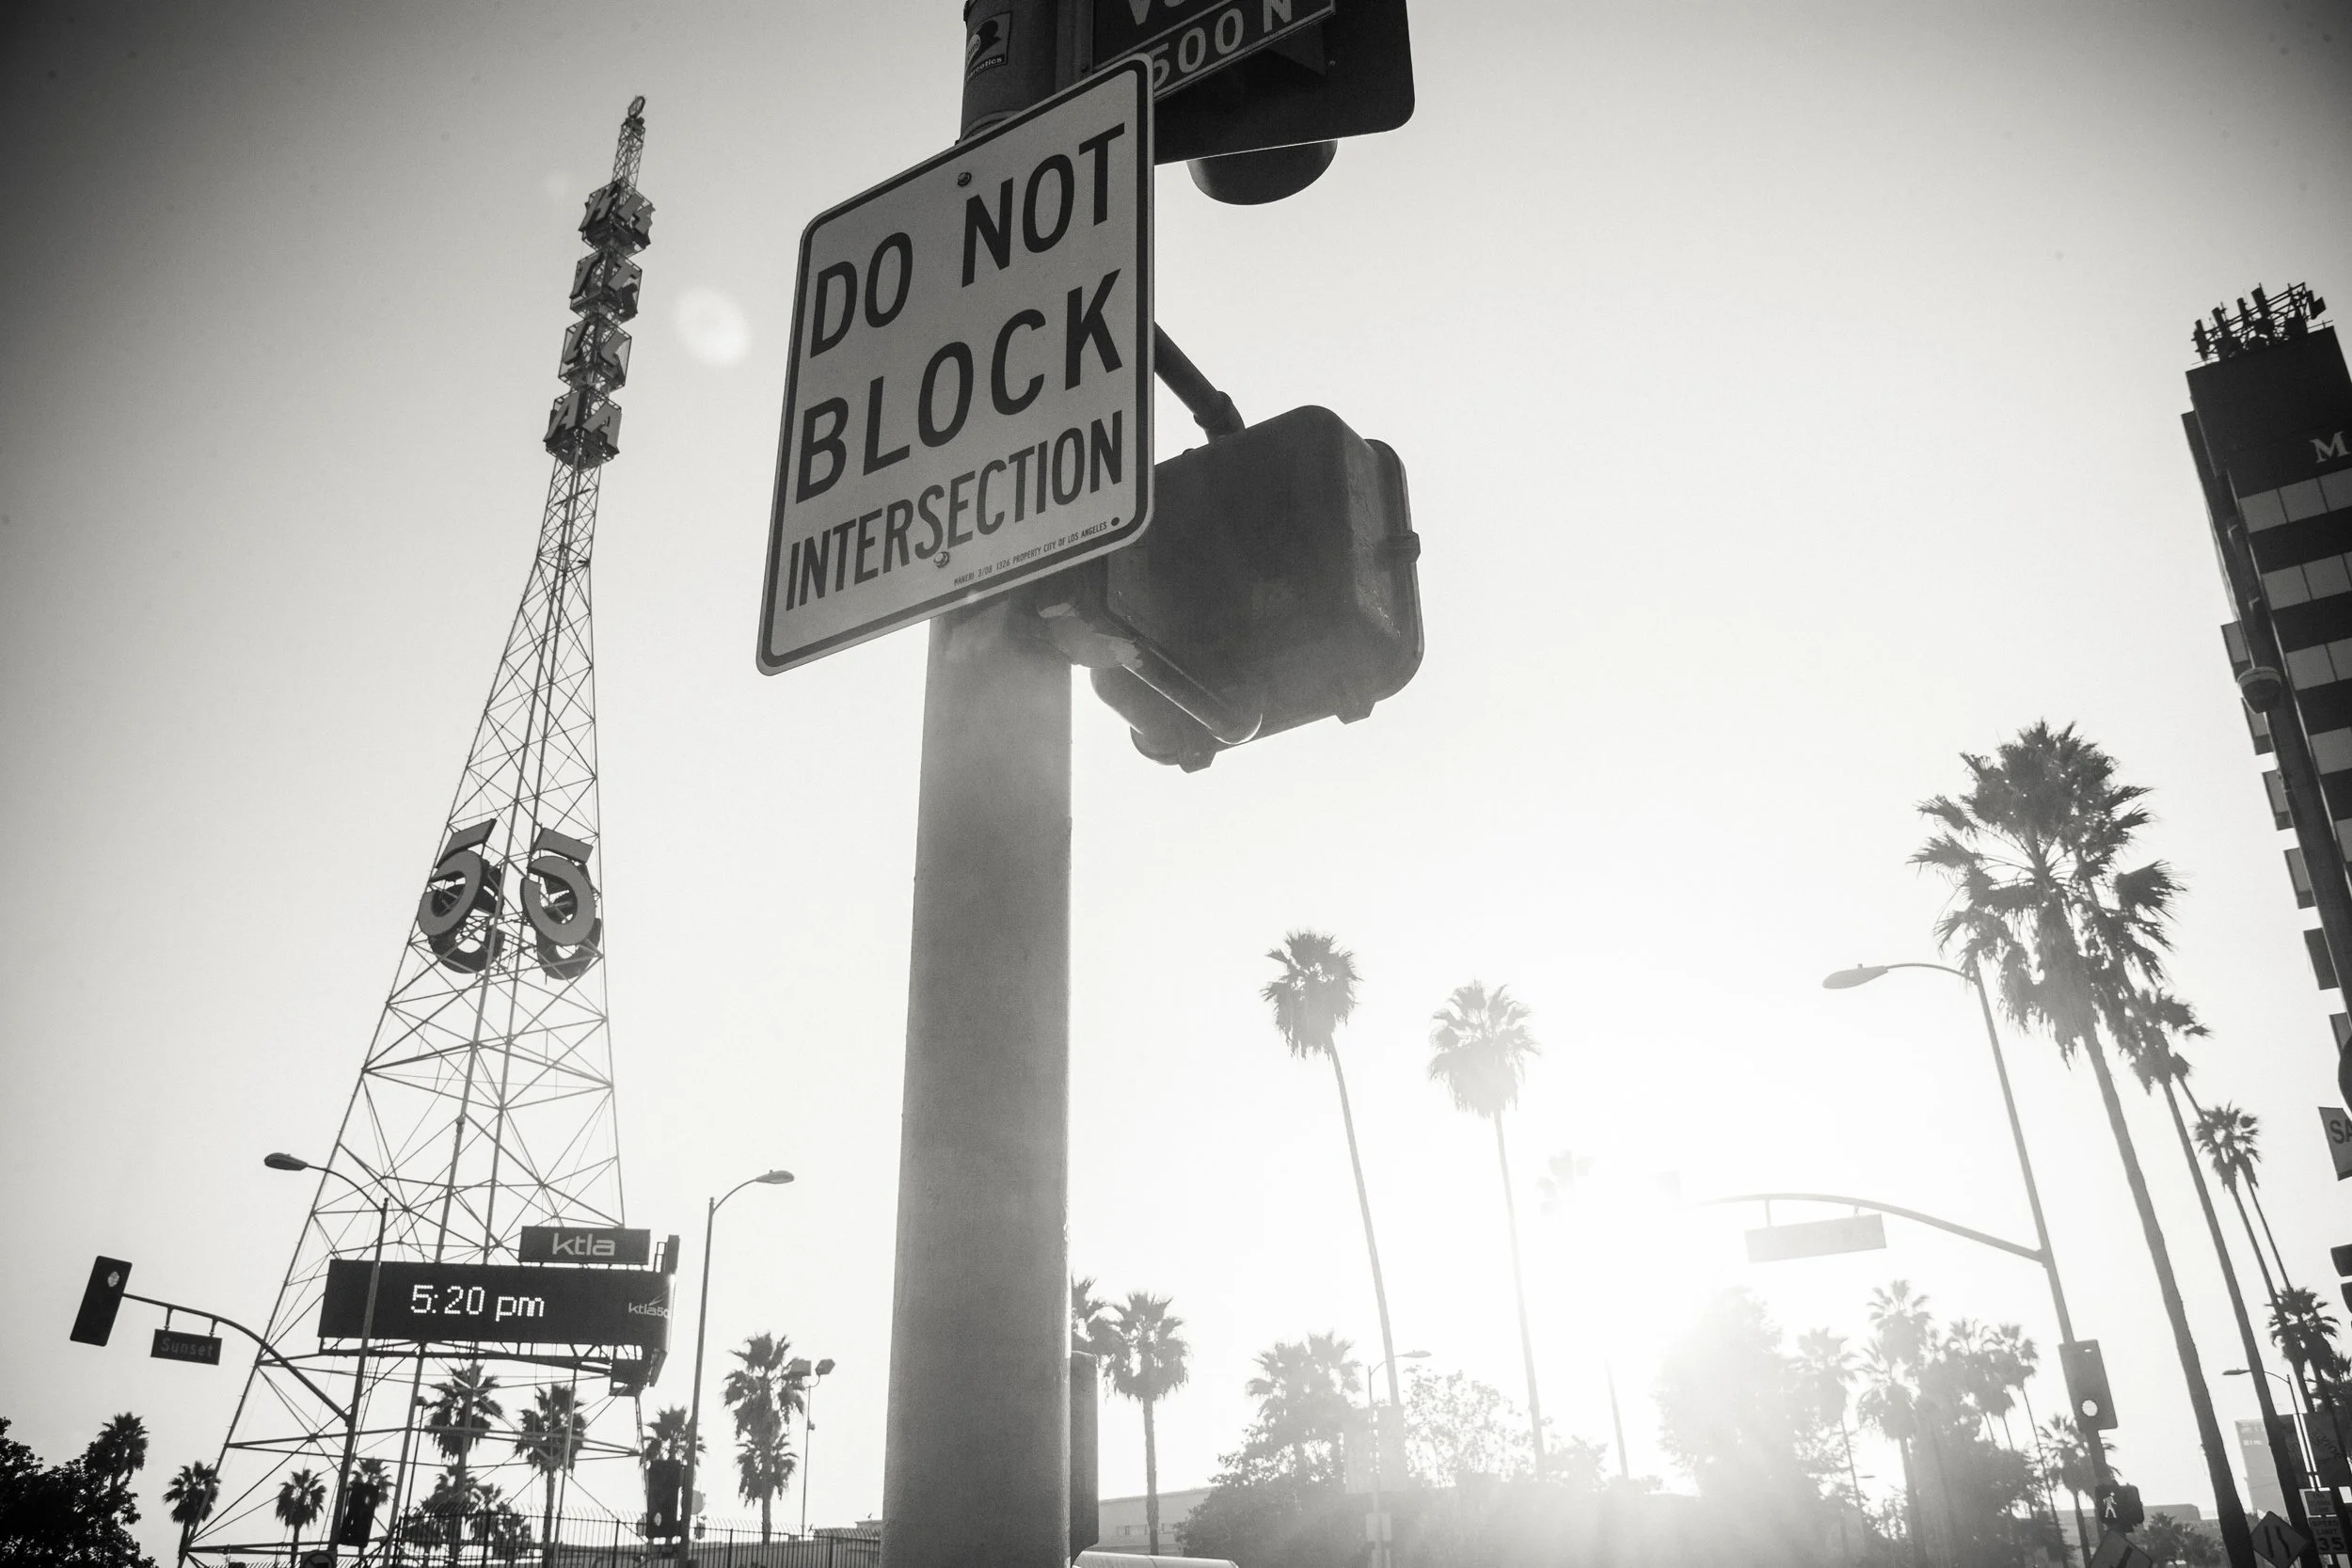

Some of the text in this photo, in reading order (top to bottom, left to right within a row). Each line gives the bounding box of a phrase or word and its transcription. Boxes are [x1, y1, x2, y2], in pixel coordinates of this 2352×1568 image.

[1263, 0, 1293, 34] N
[810, 122, 1126, 358] DO NOT
[796, 268, 1123, 504] BLOCK
[2309, 431, 2351, 463] M
[786, 410, 1123, 611] INTERSECTION
[1012, 546, 1041, 564] PROPERTY
[1043, 540, 1056, 553] CITY
[1057, 536, 1067, 546] OF
[1068, 531, 1079, 544] LOS
[1081, 521, 1107, 539] ANGELES
[551, 1232, 615, 1257] ktla
[410, 1284, 546, 1323] 5:20 pm
[161, 1337, 214, 1357] Sunset
[2312, 1518, 2339, 1528] SPEED
[2318, 1537, 2344, 1551] 35
